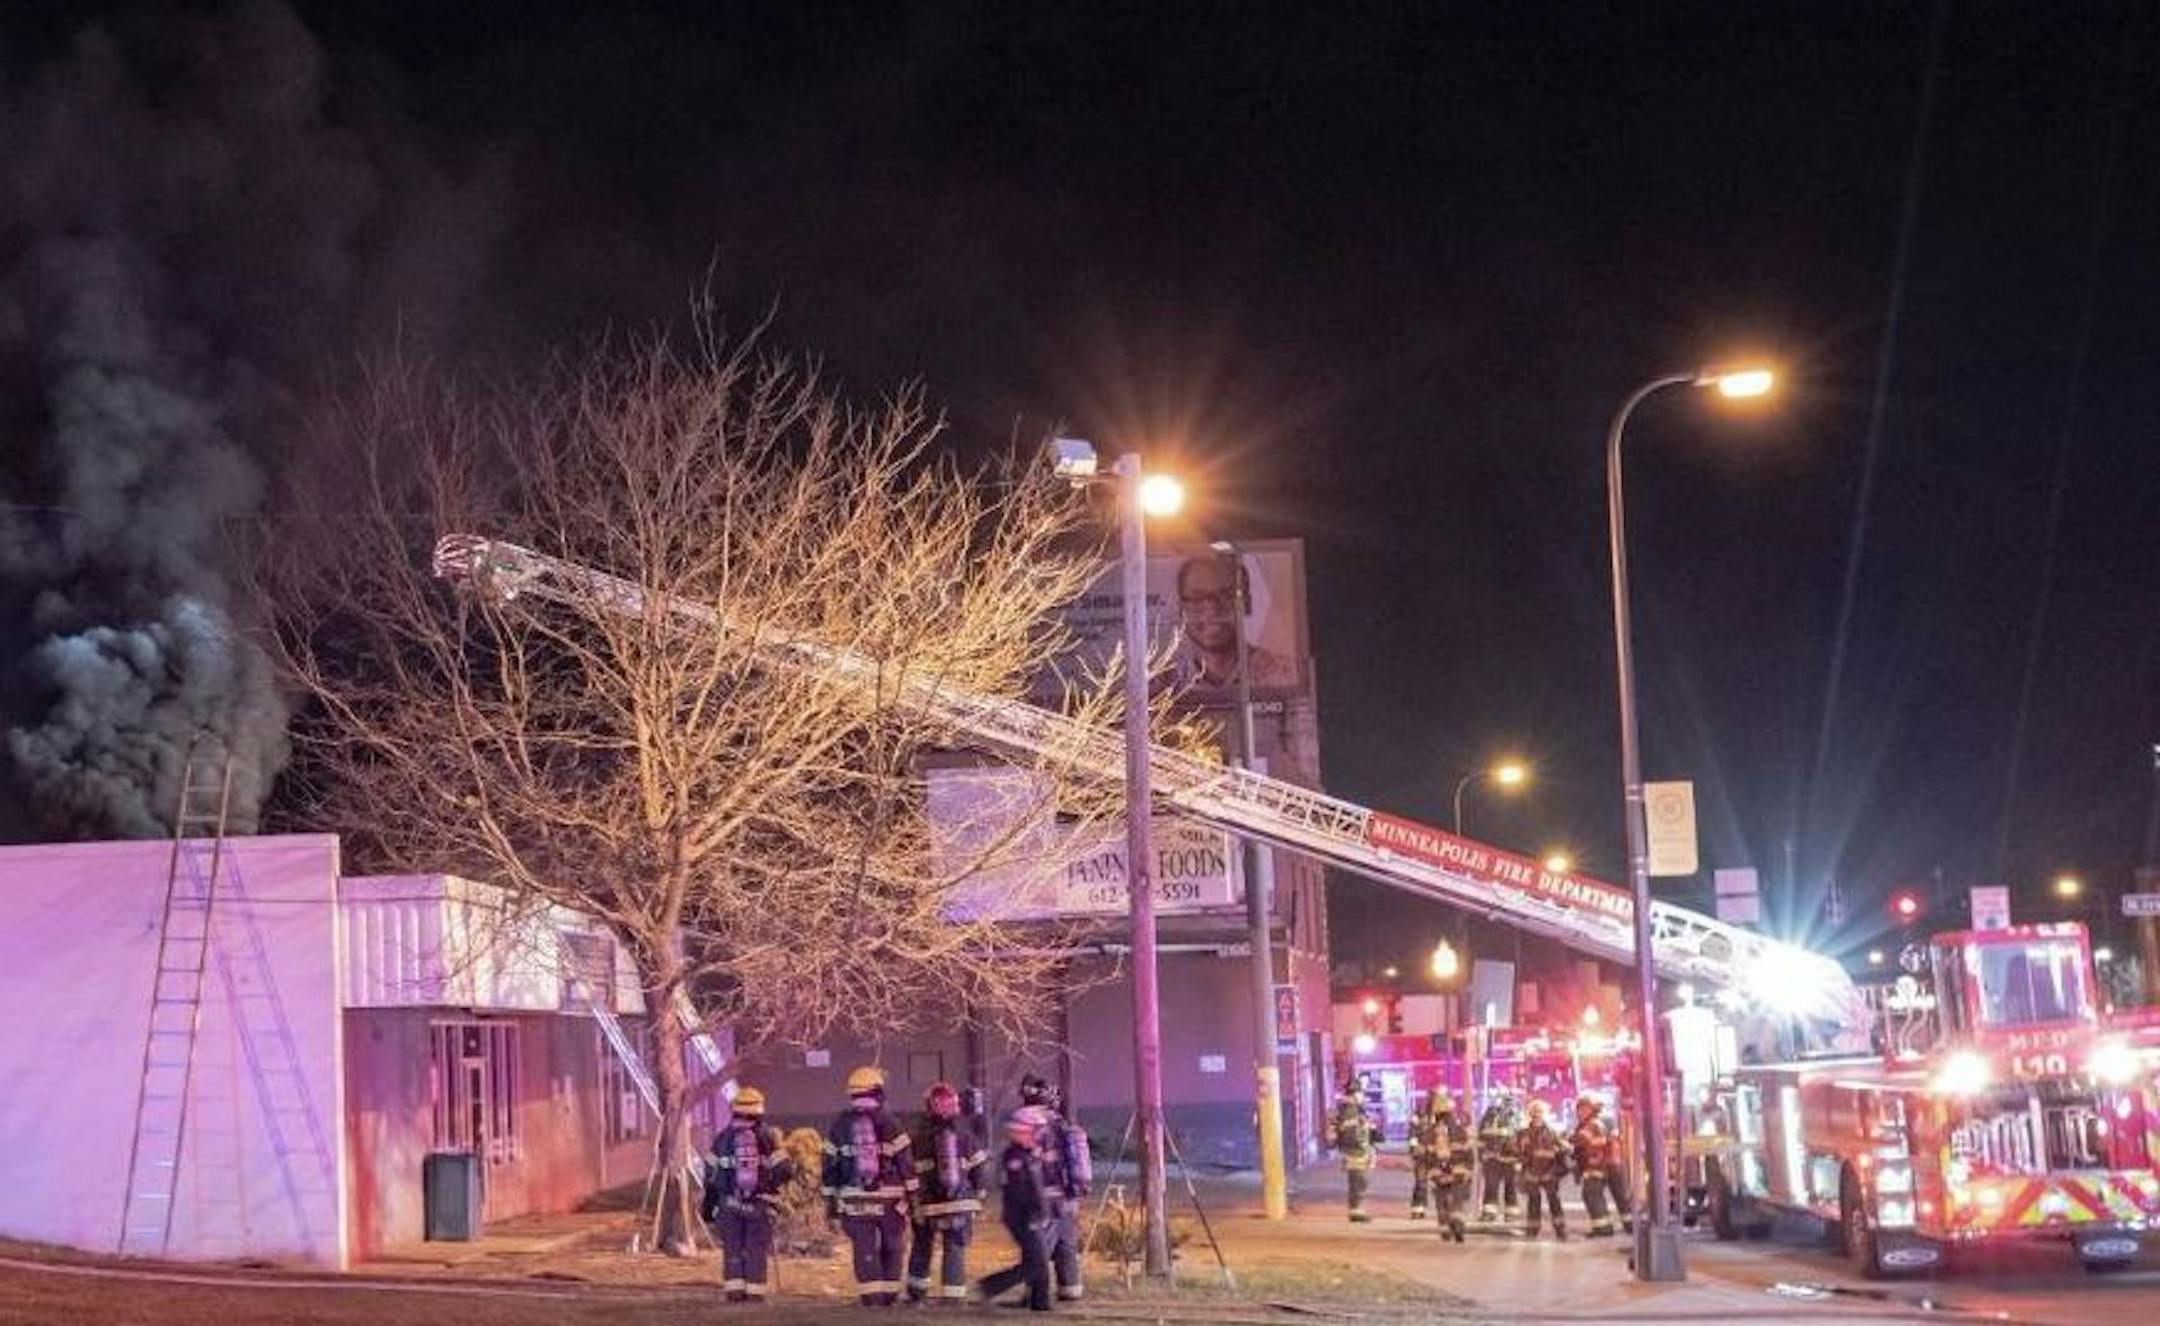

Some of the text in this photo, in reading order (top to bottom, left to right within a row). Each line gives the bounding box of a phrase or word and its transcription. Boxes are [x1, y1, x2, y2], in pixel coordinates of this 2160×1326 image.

[1158, 848, 1226, 879] FOODS
[1373, 819, 1634, 914] MINNEAPOLIS FIRE DEPARTME
